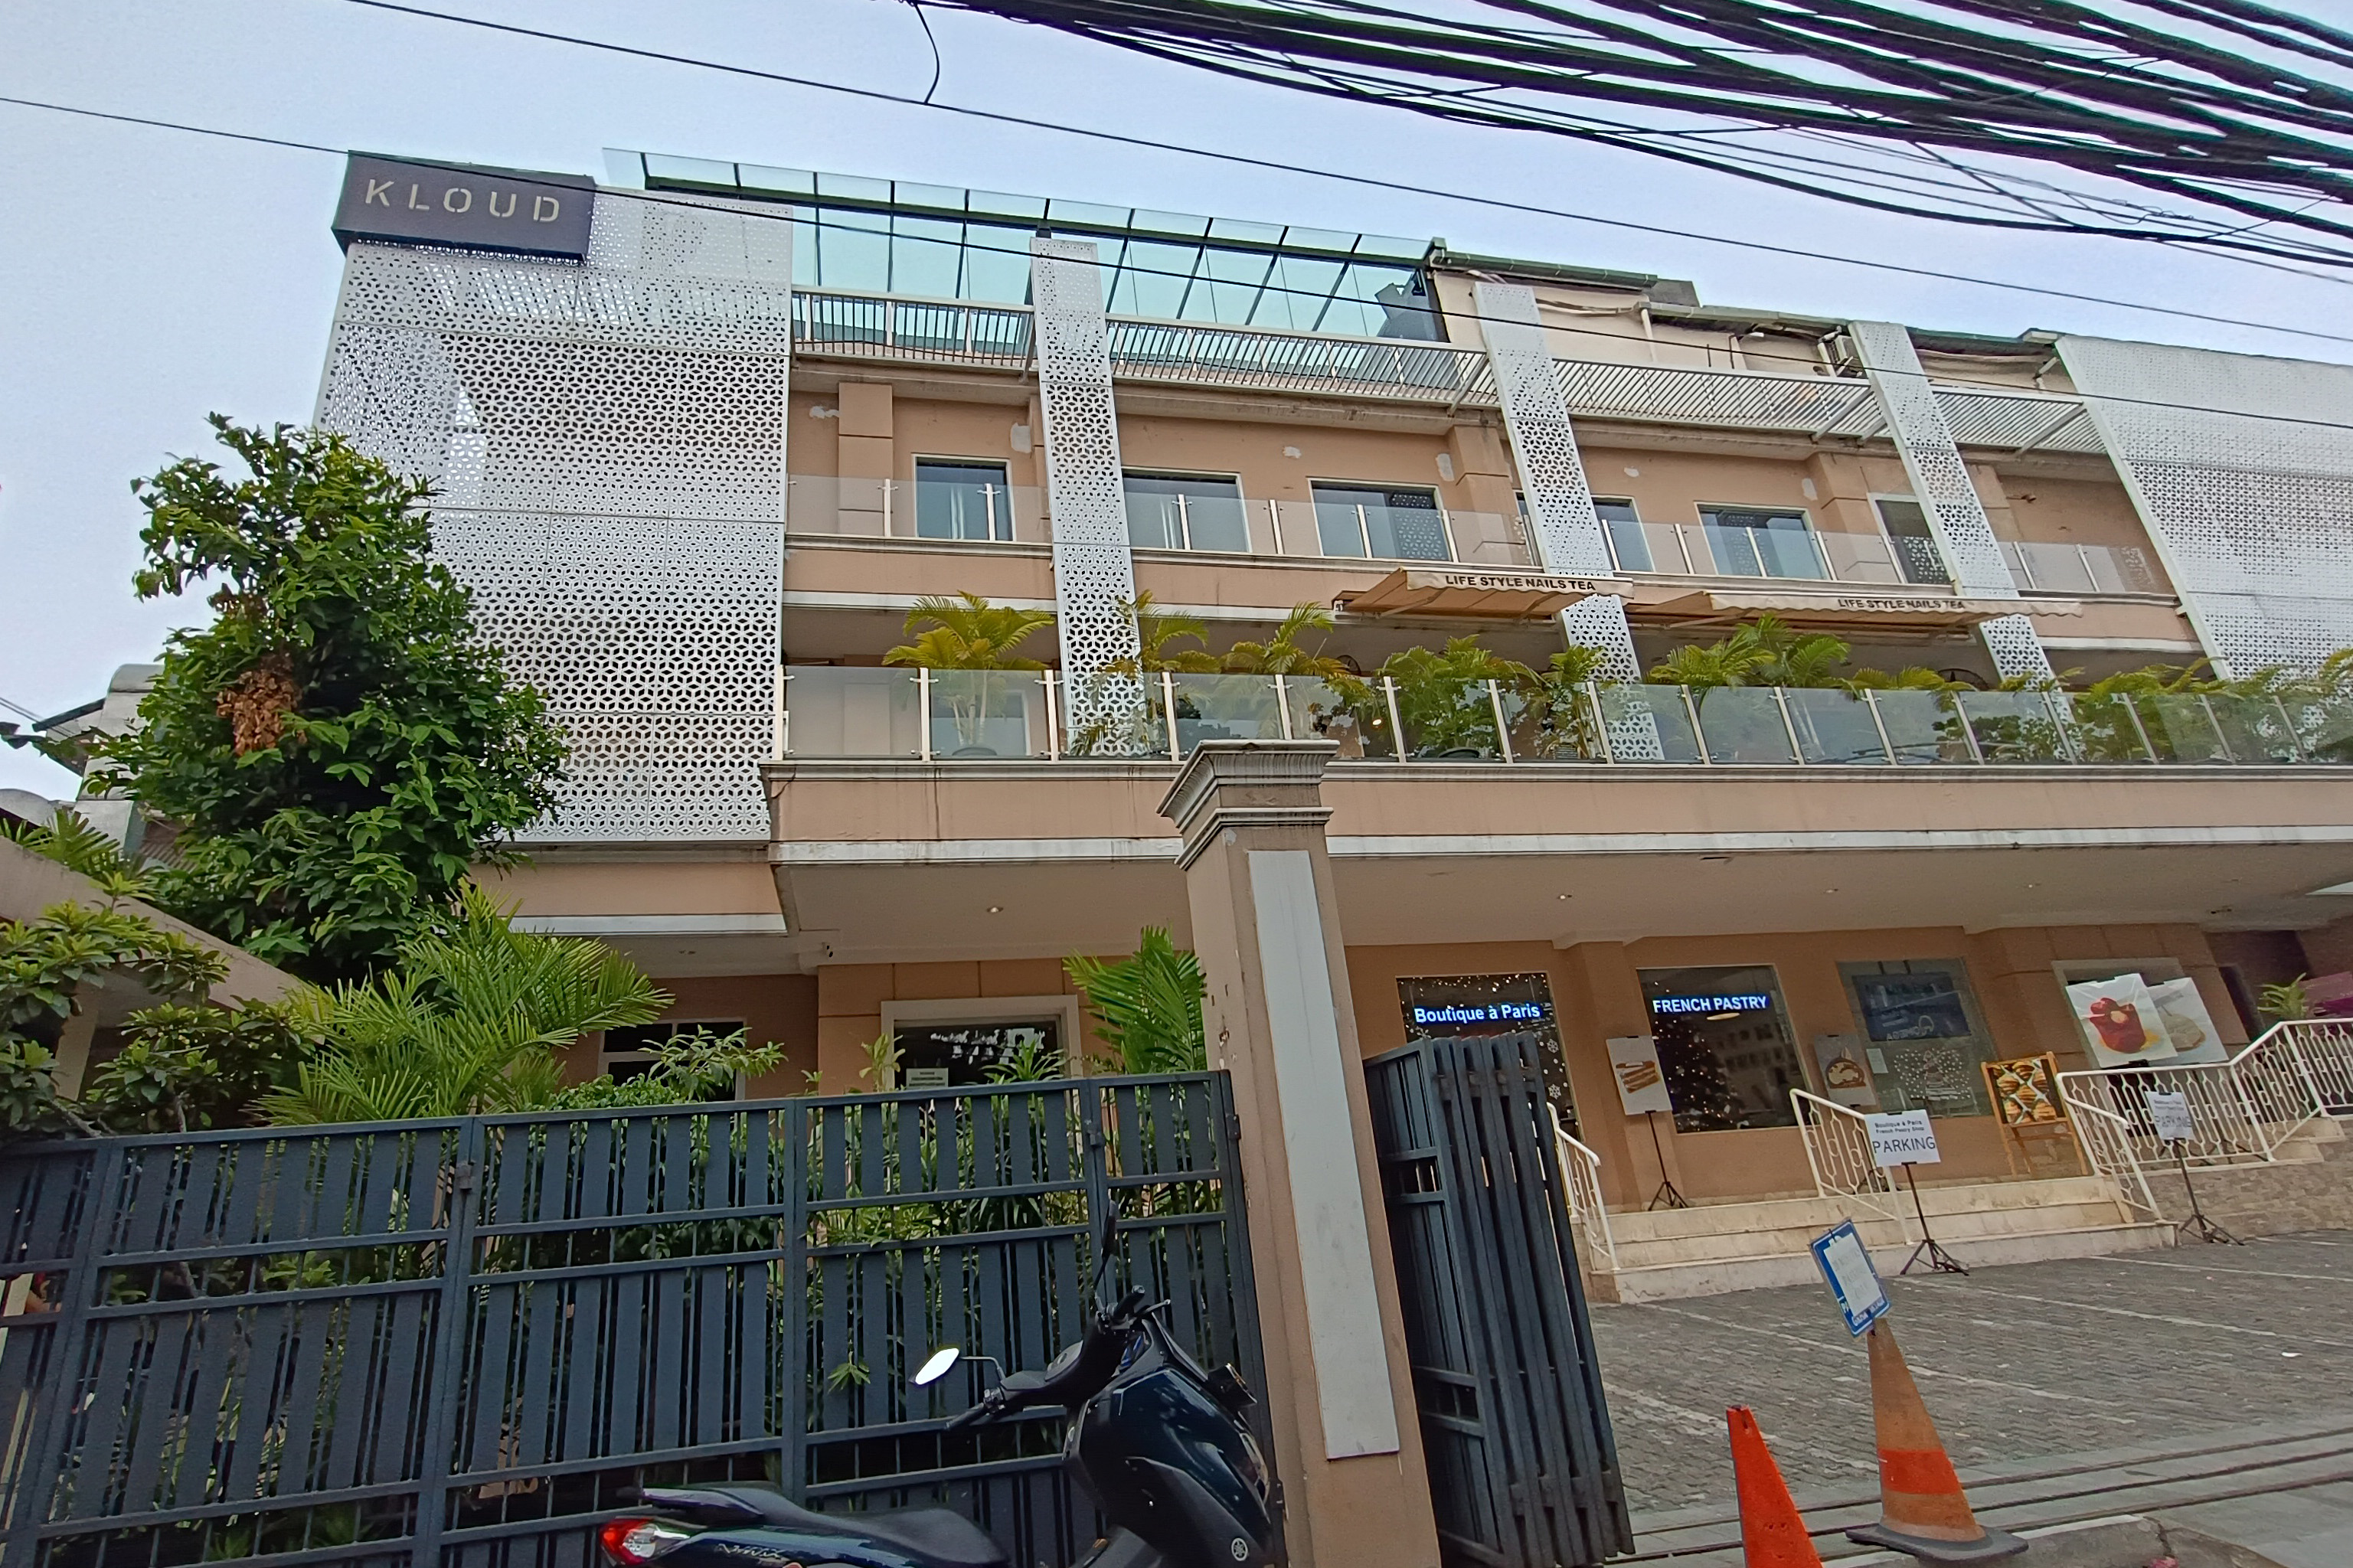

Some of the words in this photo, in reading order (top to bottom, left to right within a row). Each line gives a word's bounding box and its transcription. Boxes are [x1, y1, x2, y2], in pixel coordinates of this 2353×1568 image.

[364, 178, 560, 223] KLOUD
[1446, 575, 1477, 586] LIFE
[1480, 576, 1524, 587] STYLE
[1525, 578, 1567, 589] NAILS
[1567, 580, 1596, 591] TEA
[1838, 599, 1863, 608] LIFE
[1866, 599, 1906, 609] STYLE
[1906, 599, 1942, 609] NAILS
[1944, 600, 1966, 609] TEA
[1652, 998, 1711, 1013] FRENCH
[1712, 995, 1766, 1011] PASTRY
[1413, 1007, 1485, 1024] Boutique
[1488, 1004, 1498, 1020] à
[1501, 1003, 1541, 1019] Paris
[1871, 1136, 1936, 1154] PARKING
